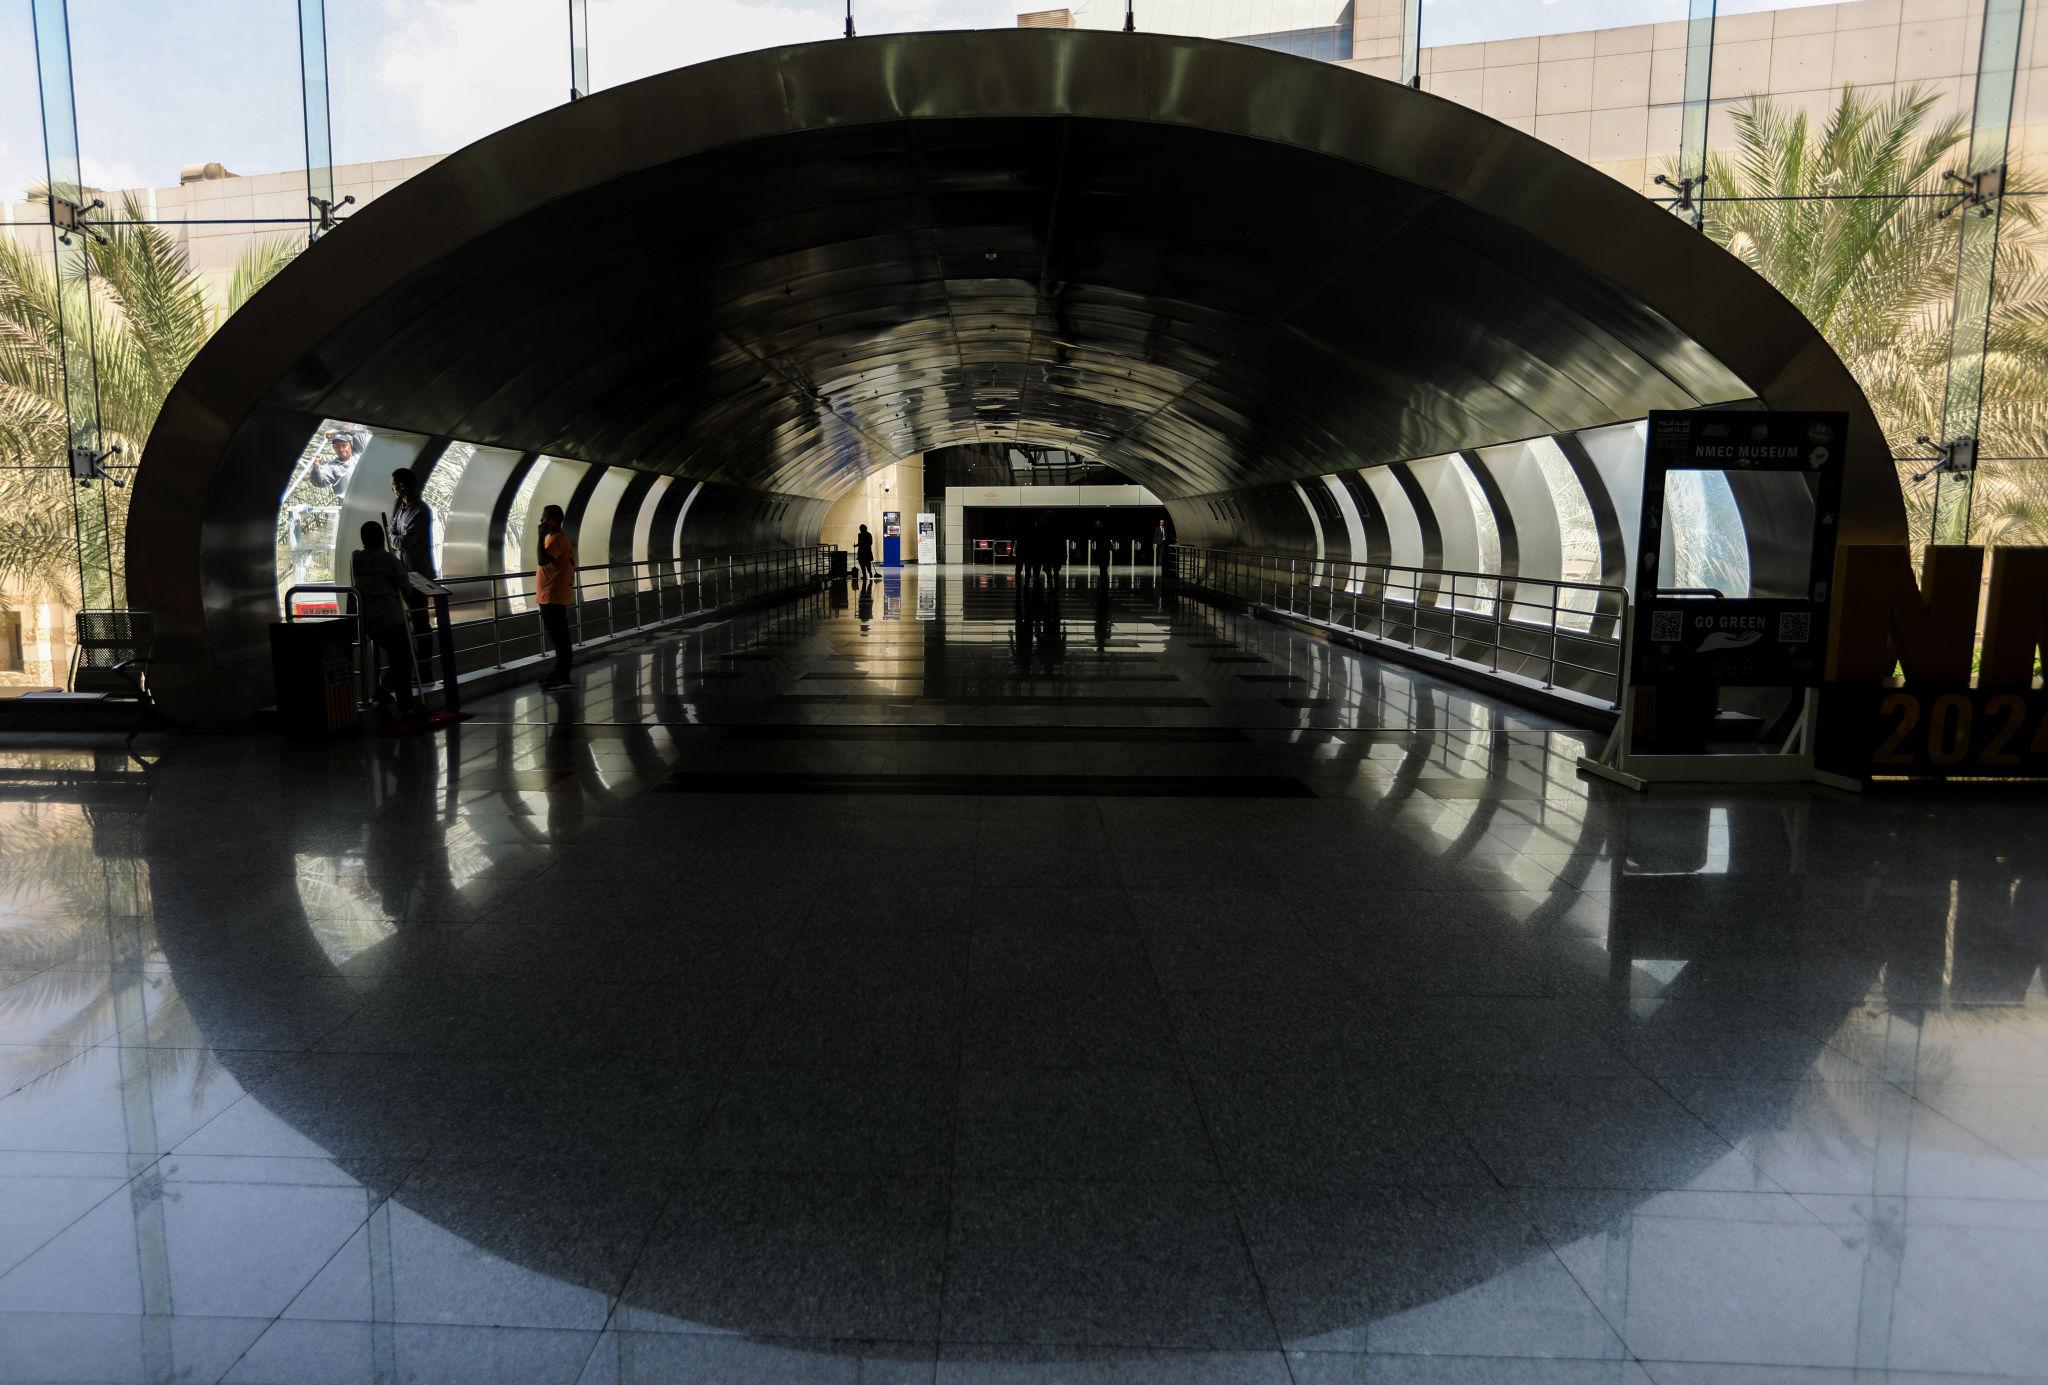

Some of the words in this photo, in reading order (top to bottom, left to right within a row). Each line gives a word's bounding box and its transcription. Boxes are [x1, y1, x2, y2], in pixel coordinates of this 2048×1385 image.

[1695, 446, 1735, 458] NMEC
[1738, 446, 1799, 459] MUSEUM
[1694, 615, 1714, 628] GO
[1719, 615, 1767, 629] GREEN
